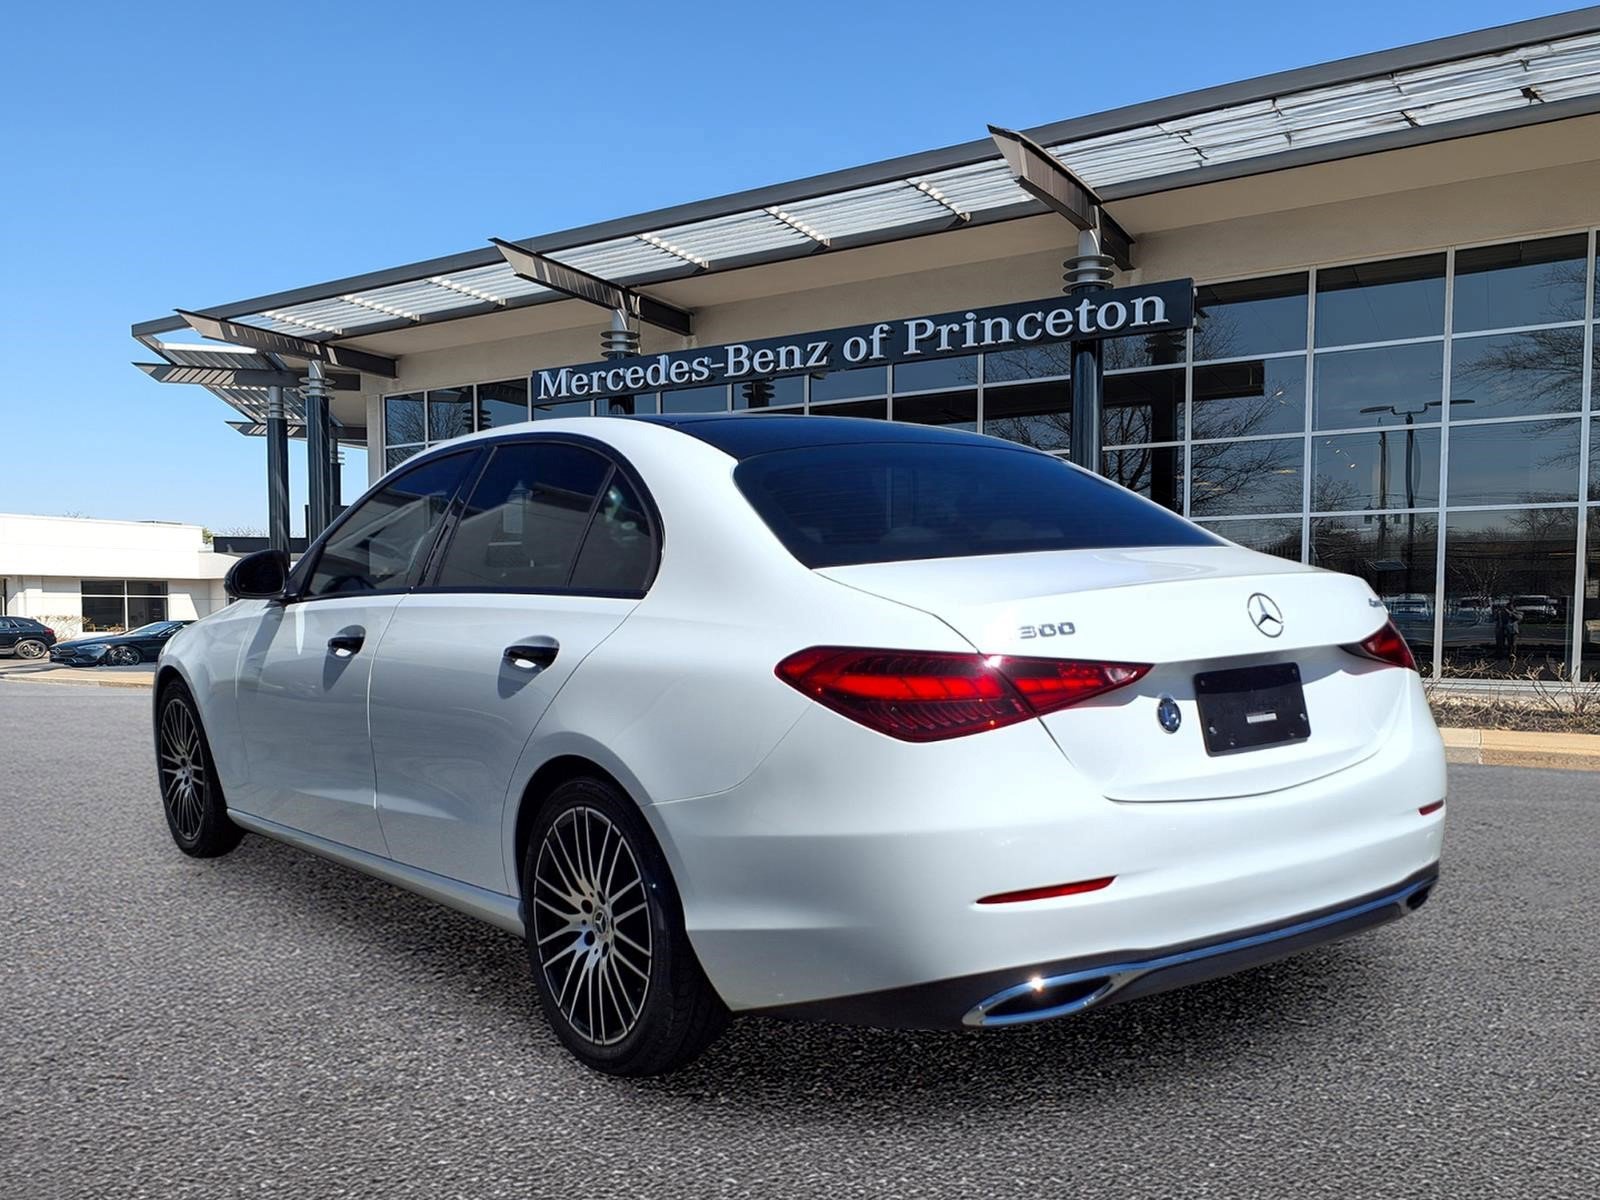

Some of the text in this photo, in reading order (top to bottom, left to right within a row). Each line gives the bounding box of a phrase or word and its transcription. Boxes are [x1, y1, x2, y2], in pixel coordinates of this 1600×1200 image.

[537, 294, 1169, 400] Mercedes-Benz of Princeton
[1018, 621, 1076, 640] 300
